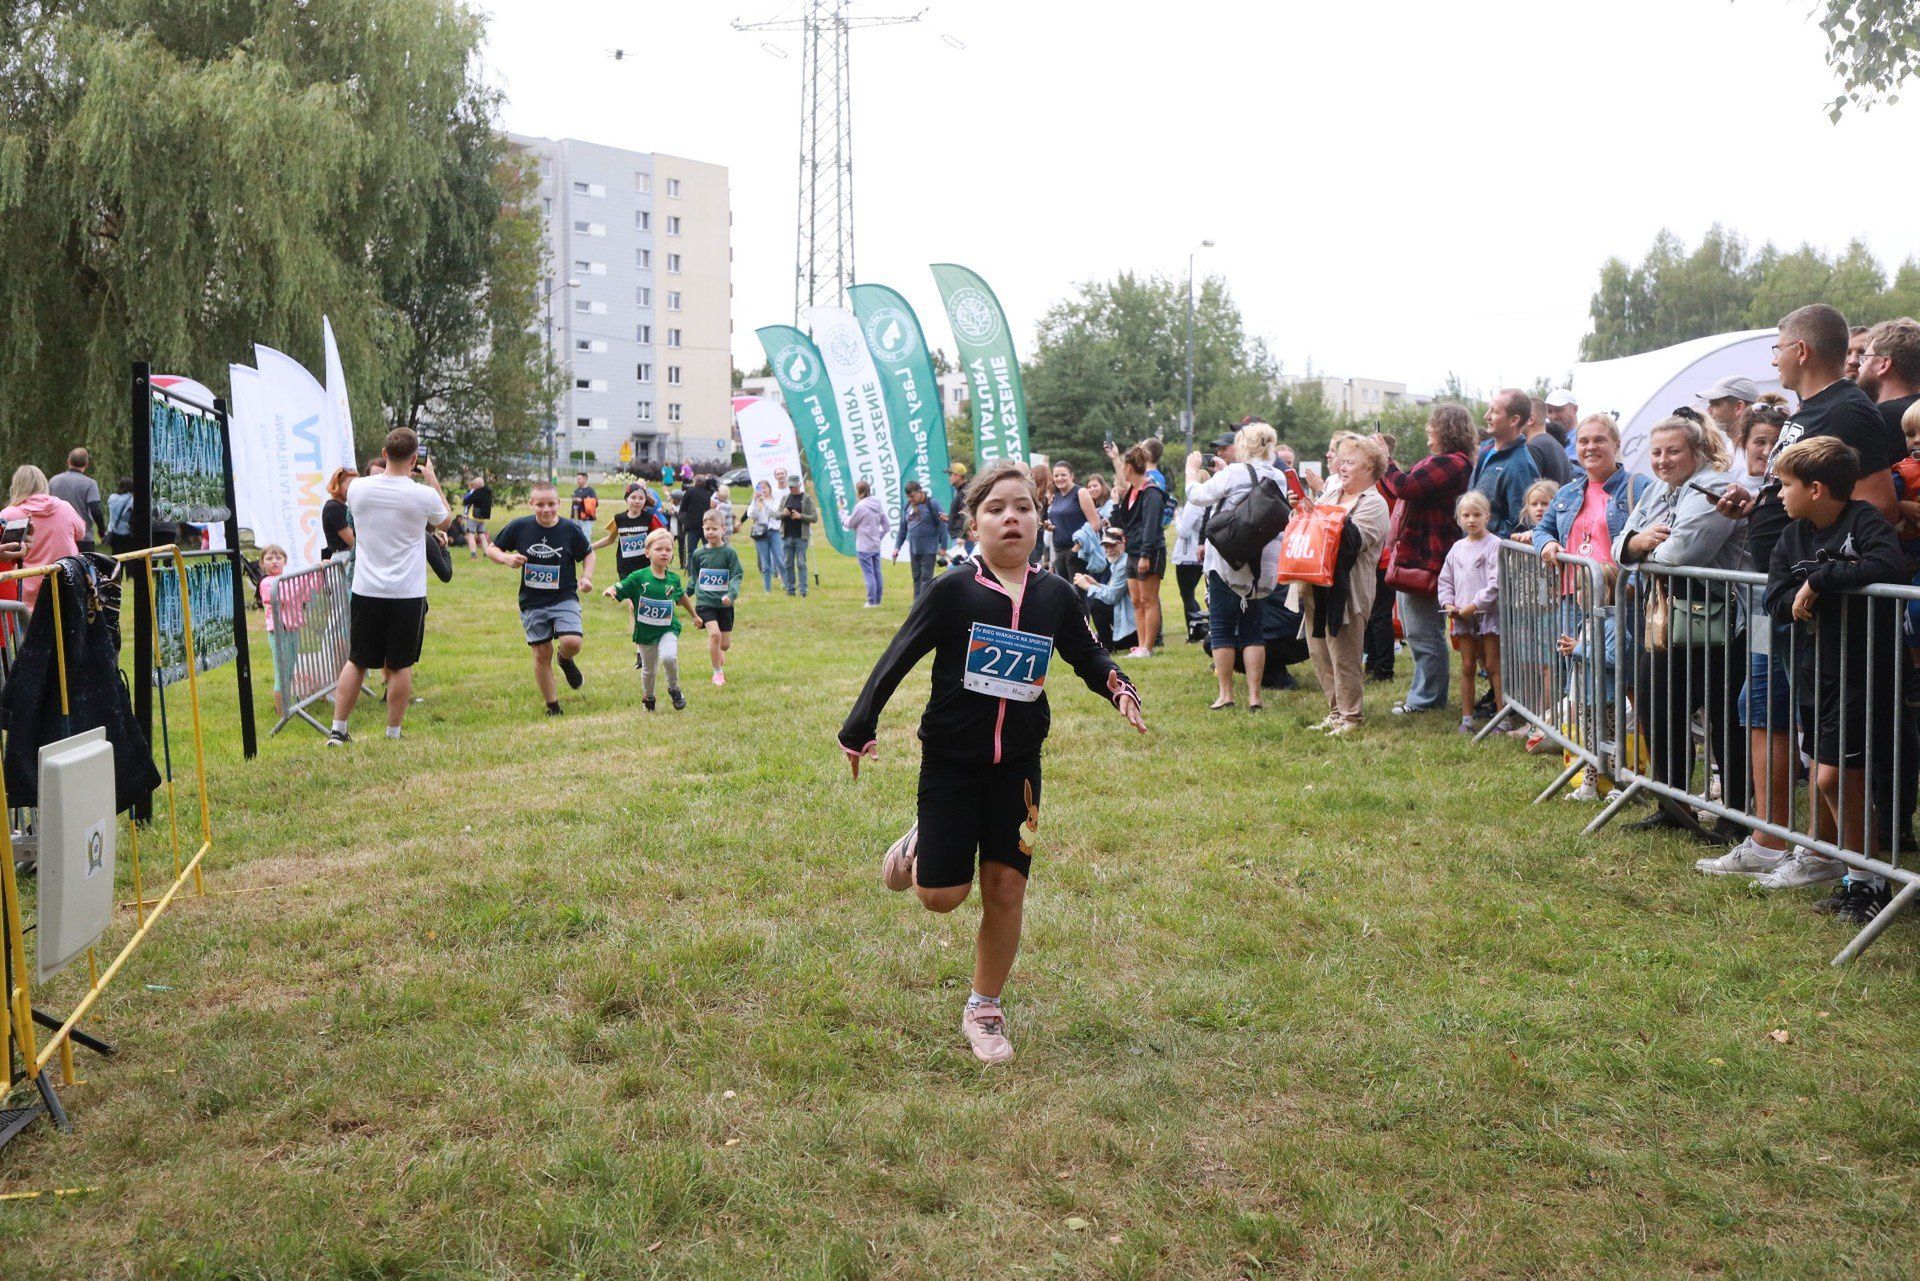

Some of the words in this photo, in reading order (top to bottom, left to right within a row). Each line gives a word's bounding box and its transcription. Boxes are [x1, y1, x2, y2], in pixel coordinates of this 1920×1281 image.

[624, 540, 644, 551] 299
[530, 571, 553, 582] 298
[704, 575, 724, 585] 296
[643, 605, 668, 618] 287
[980, 646, 1036, 681] 271
